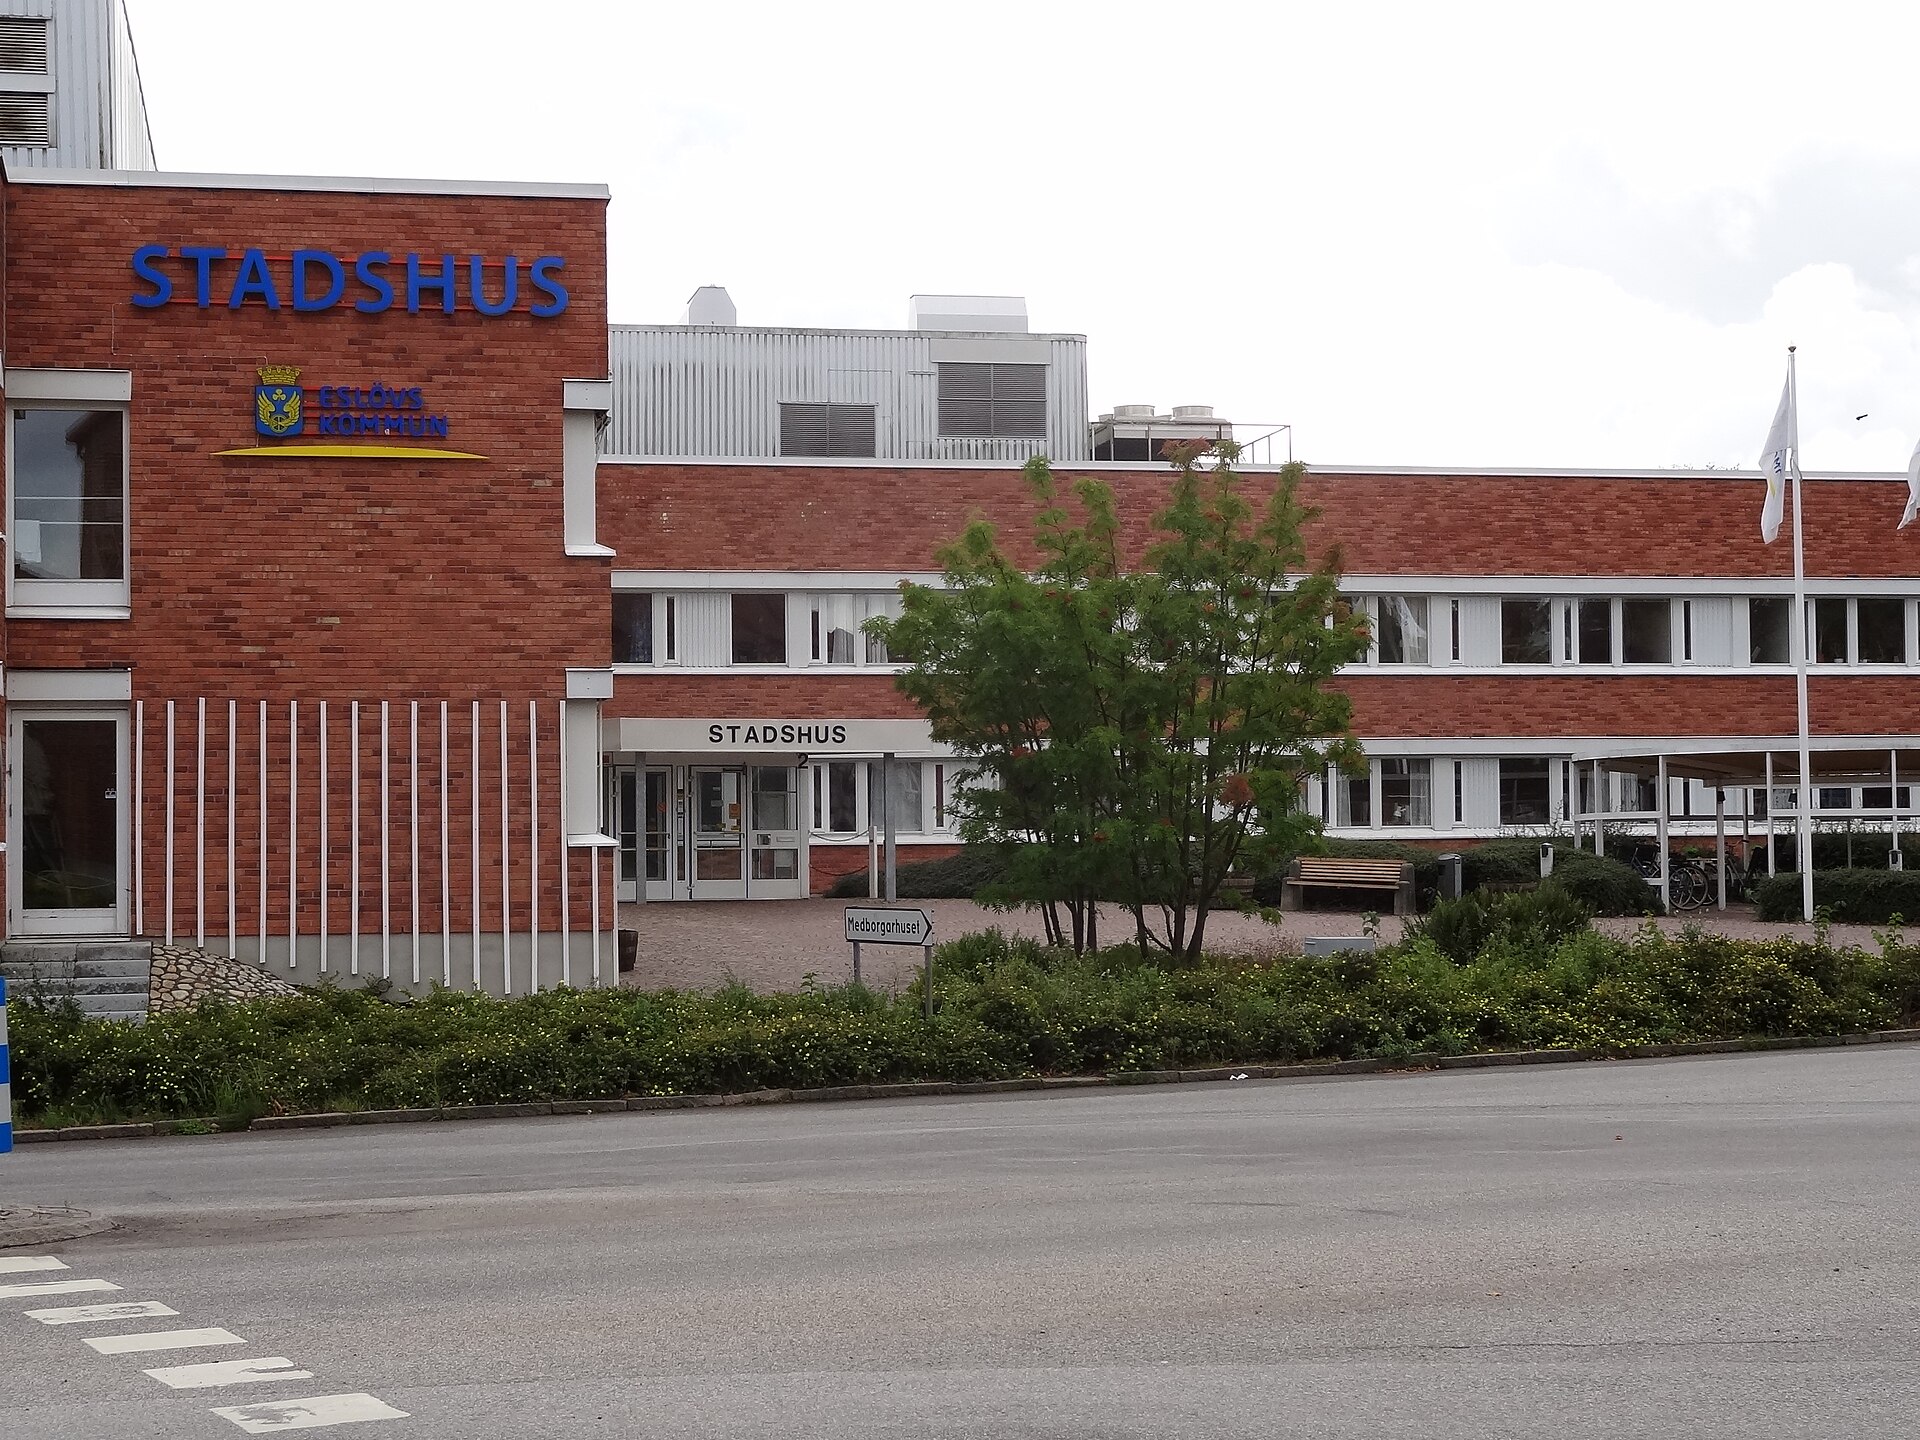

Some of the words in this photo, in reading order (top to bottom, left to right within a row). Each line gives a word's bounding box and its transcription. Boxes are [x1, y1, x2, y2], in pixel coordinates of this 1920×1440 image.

[131, 245, 569, 317] STADSHUS
[319, 382, 424, 410] ESLÖVS
[319, 414, 448, 437] KOMMUN
[708, 724, 847, 744] STADSHUS
[797, 753, 809, 769] 2
[847, 916, 921, 936] Medborgarhuset
